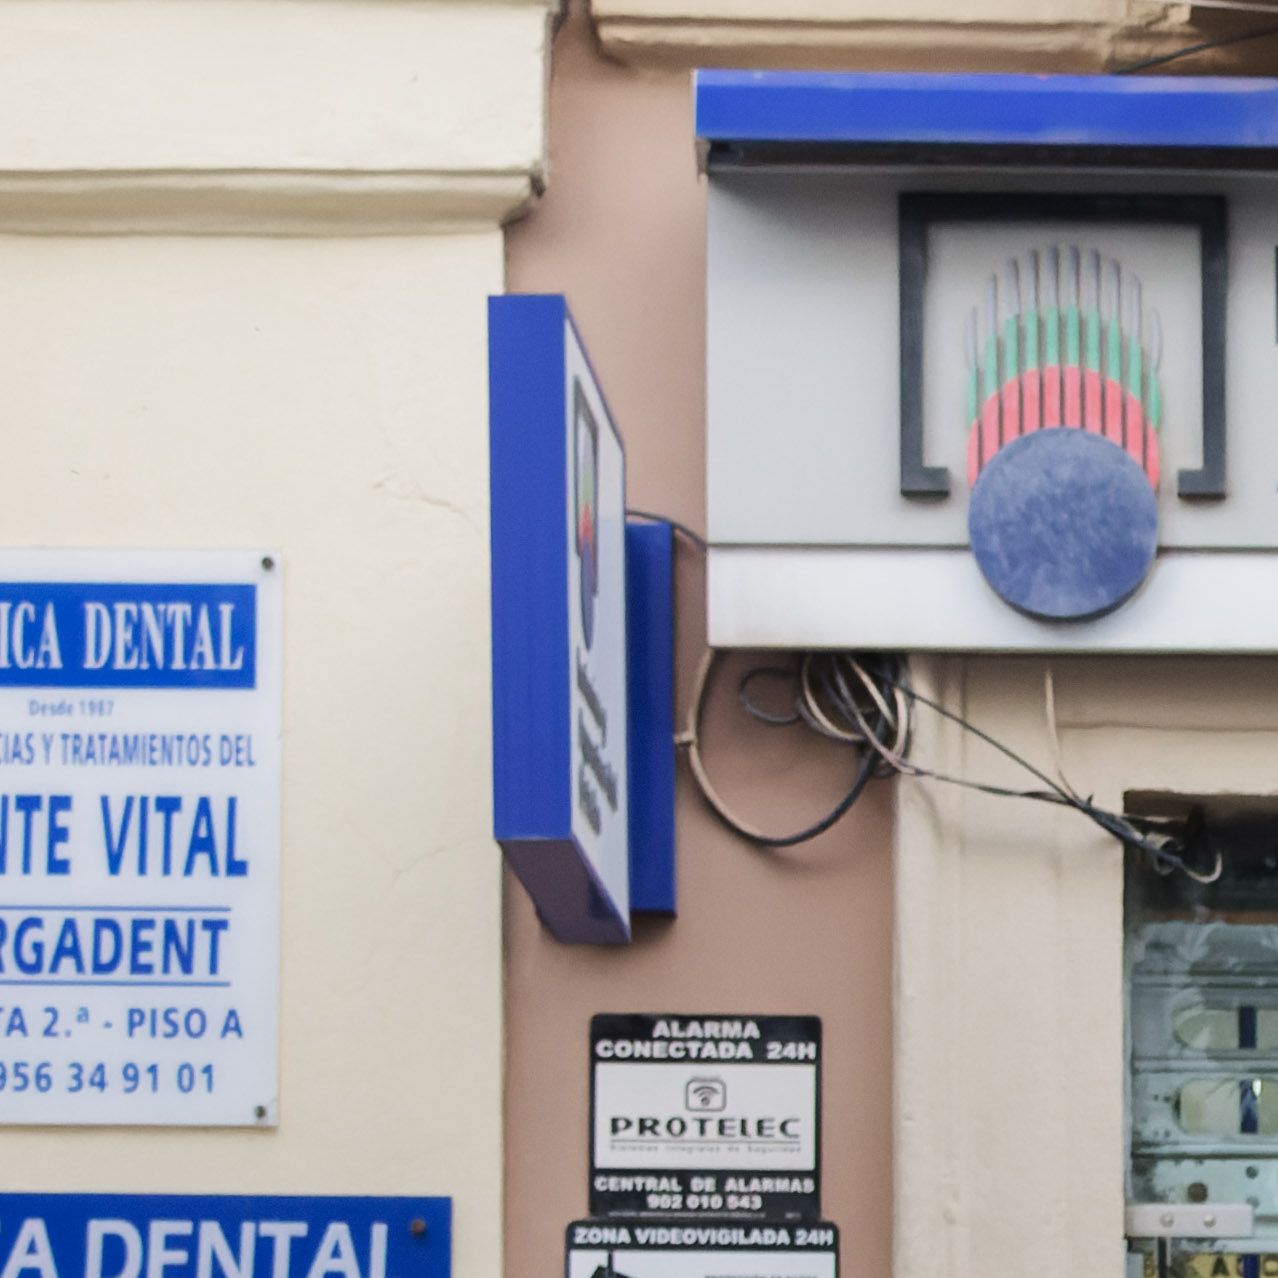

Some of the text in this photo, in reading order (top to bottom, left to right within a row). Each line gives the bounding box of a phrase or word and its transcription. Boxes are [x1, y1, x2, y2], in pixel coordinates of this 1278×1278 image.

[84, 603, 243, 671] DENTAL
[29, 700, 74, 717] Desde
[0, 732, 256, 768] IAS Y TRATAMIENTOS DEL
[100, 796, 248, 877] VITAL
[0, 916, 229, 975] GADENT
[0, 1006, 28, 1037] A
[128, 1007, 207, 1040] PISO
[222, 1009, 244, 1039] A
[652, 1020, 760, 1039] ALARMA
[596, 1039, 816, 1060] CONECTADA 24H
[67, 1062, 107, 1093] 34
[122, 1063, 160, 1094] 91
[177, 1063, 215, 1094] 01
[610, 1116, 800, 1139] PROTELEC
[594, 1175, 815, 1193] CENTRAL DE ALARMAS
[574, 1228, 834, 1245] ZONA VIDEOVIGILADA 24H
